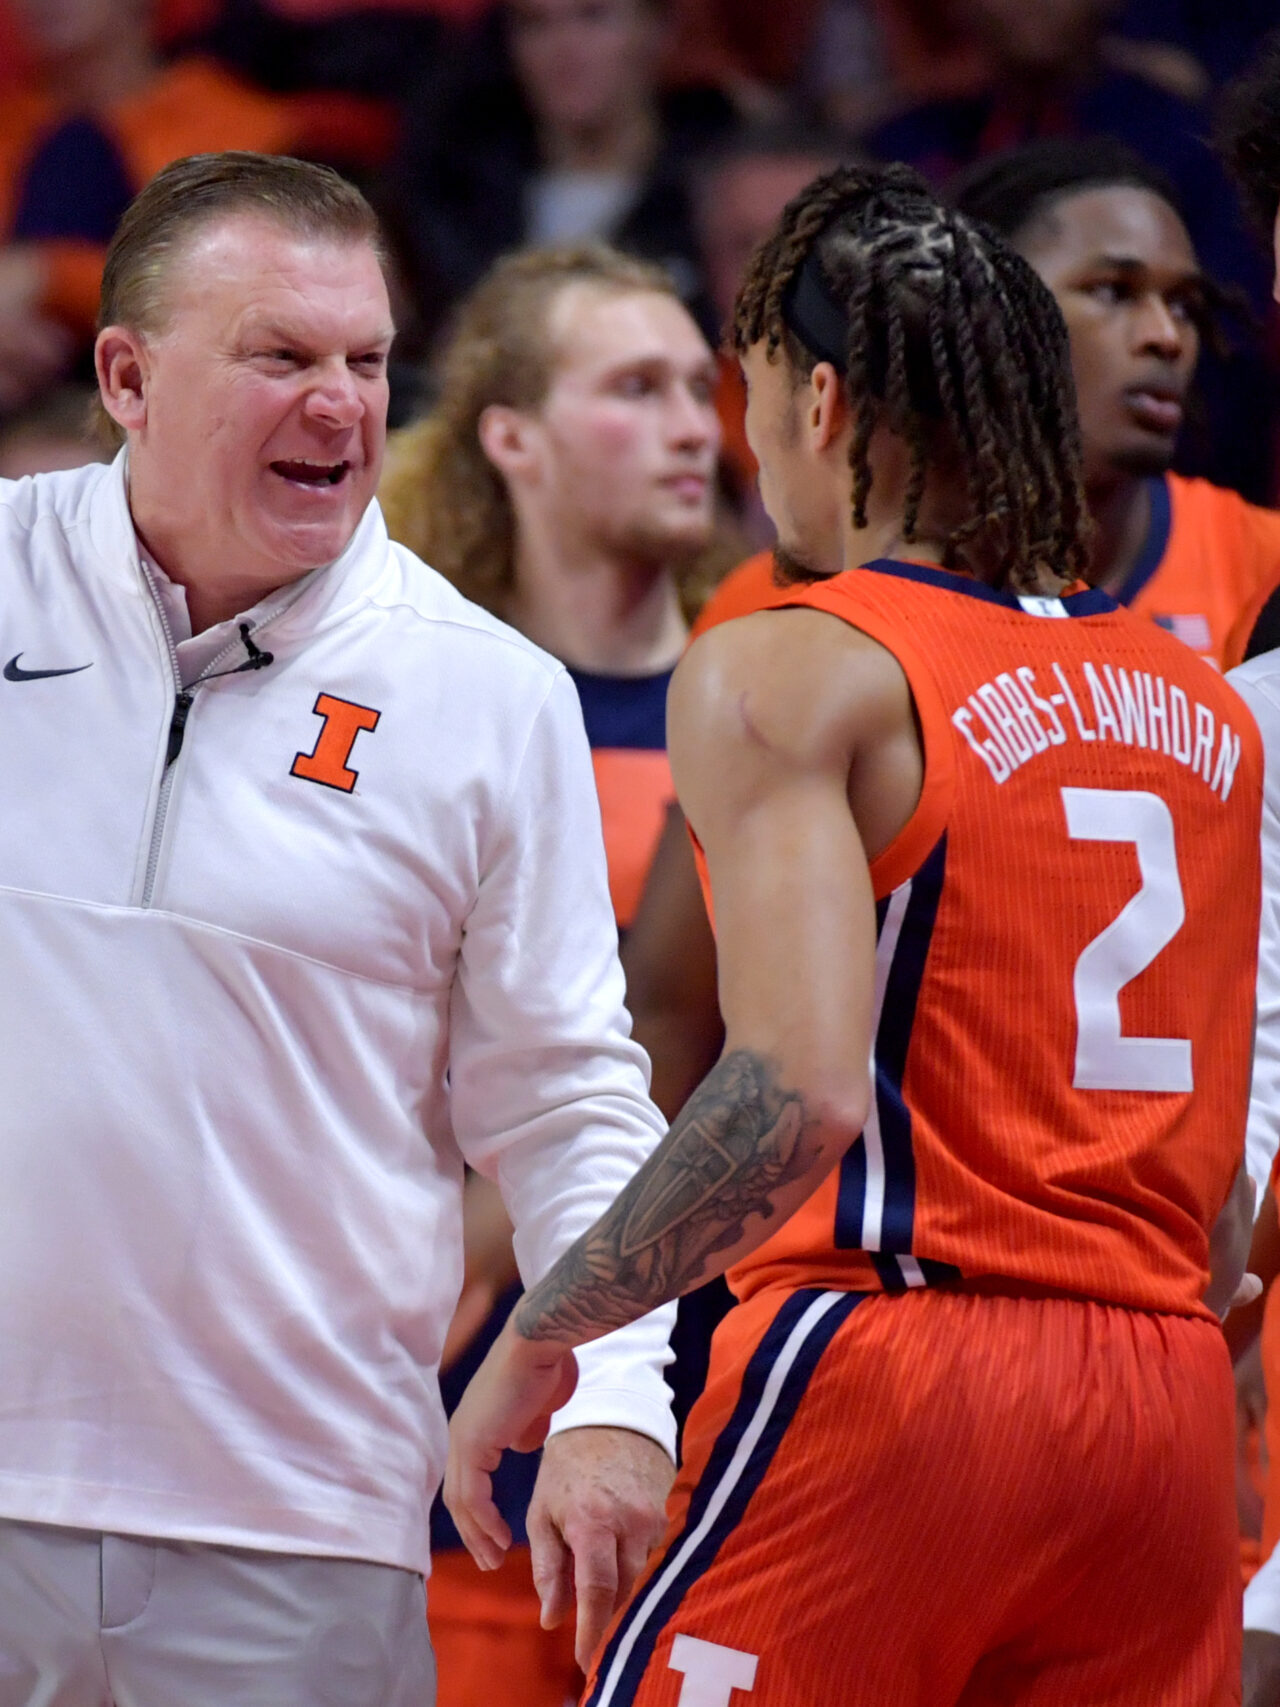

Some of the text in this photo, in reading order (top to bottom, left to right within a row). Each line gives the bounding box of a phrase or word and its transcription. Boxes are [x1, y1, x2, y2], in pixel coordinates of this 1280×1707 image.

[289, 691, 382, 794] I
[951, 662, 1240, 802] GIBBS-LAWHORN
[1060, 787, 1194, 1092] 2
